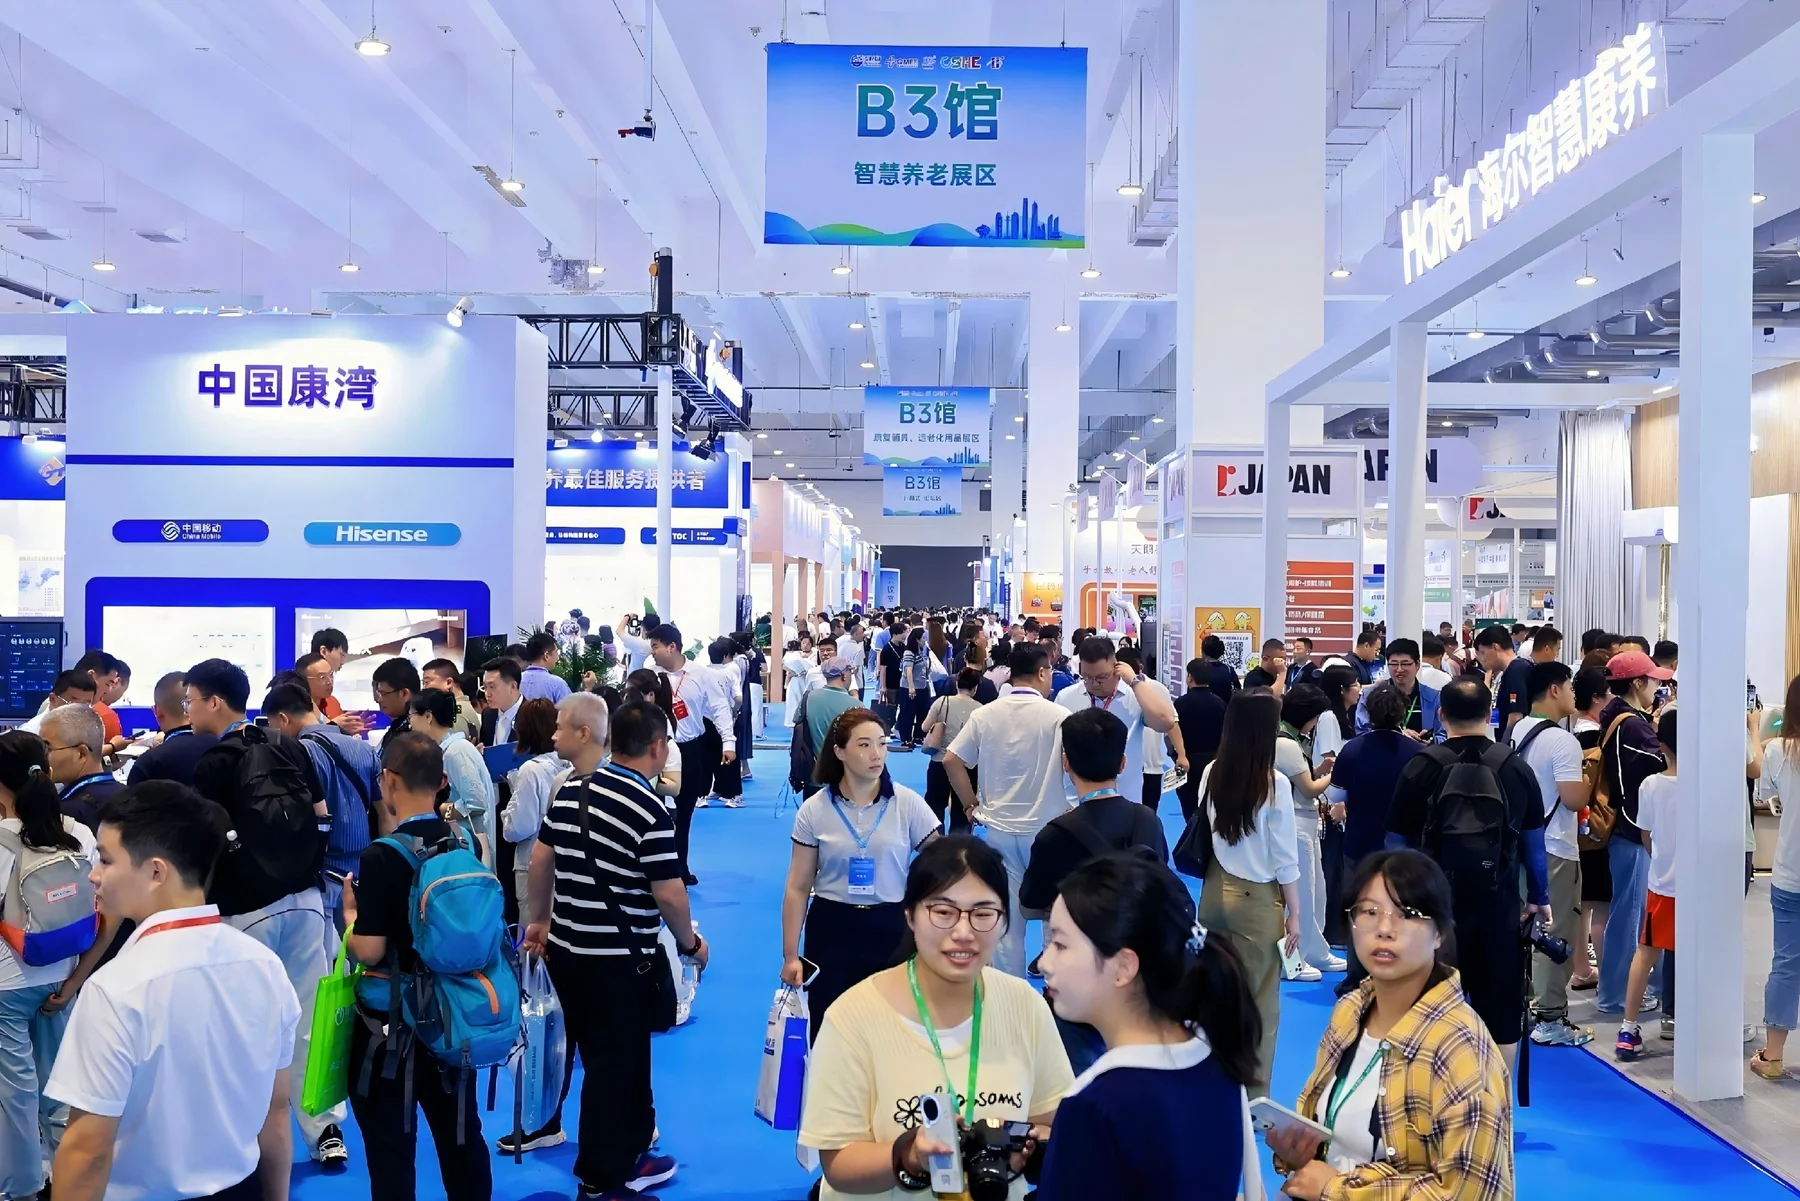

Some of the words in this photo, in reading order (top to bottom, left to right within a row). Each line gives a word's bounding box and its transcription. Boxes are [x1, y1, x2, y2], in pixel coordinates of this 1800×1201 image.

[856, 82, 1002, 141] B3馆
[1401, 168, 1478, 285] Haier
[1477, 22, 1657, 230] 海尔智慧康养
[854, 161, 998, 187] 智慧养老展区
[198, 363, 379, 410] 中国康湾
[899, 401, 957, 425] B3馆
[905, 475, 941, 490] B3馆
[1238, 463, 1331, 496] JAN
[182, 523, 222, 533] 中国移动
[336, 525, 429, 542] Hisense
